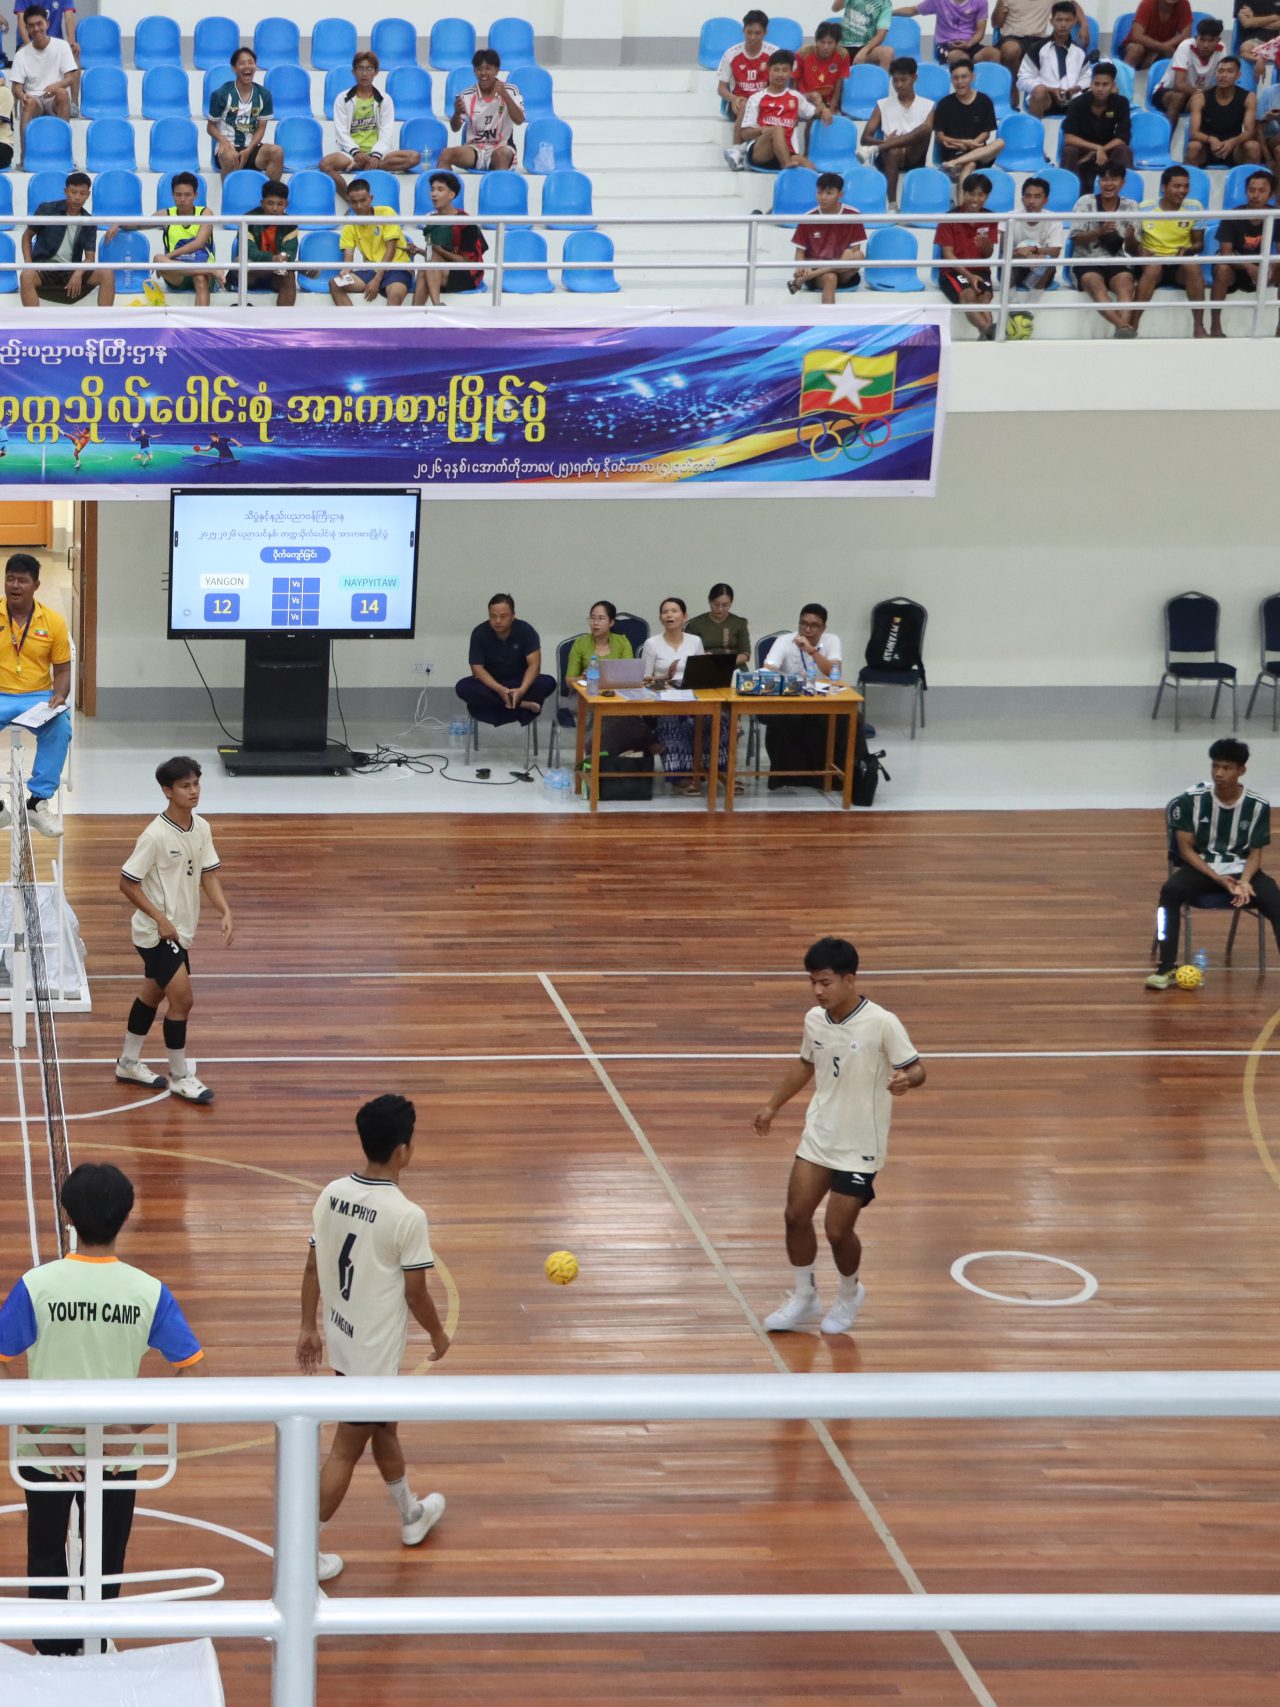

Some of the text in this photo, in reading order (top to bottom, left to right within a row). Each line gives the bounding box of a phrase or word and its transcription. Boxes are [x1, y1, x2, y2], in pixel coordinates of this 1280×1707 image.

[746, 69, 757, 81] 10
[205, 577, 245, 586] YANGON
[344, 578, 397, 587] NAYPYITAW
[213, 599, 233, 614] 12
[360, 599, 380, 614] 14
[832, 1056, 840, 1078] 5
[47, 1301, 141, 1325] YOUTH CAMP
